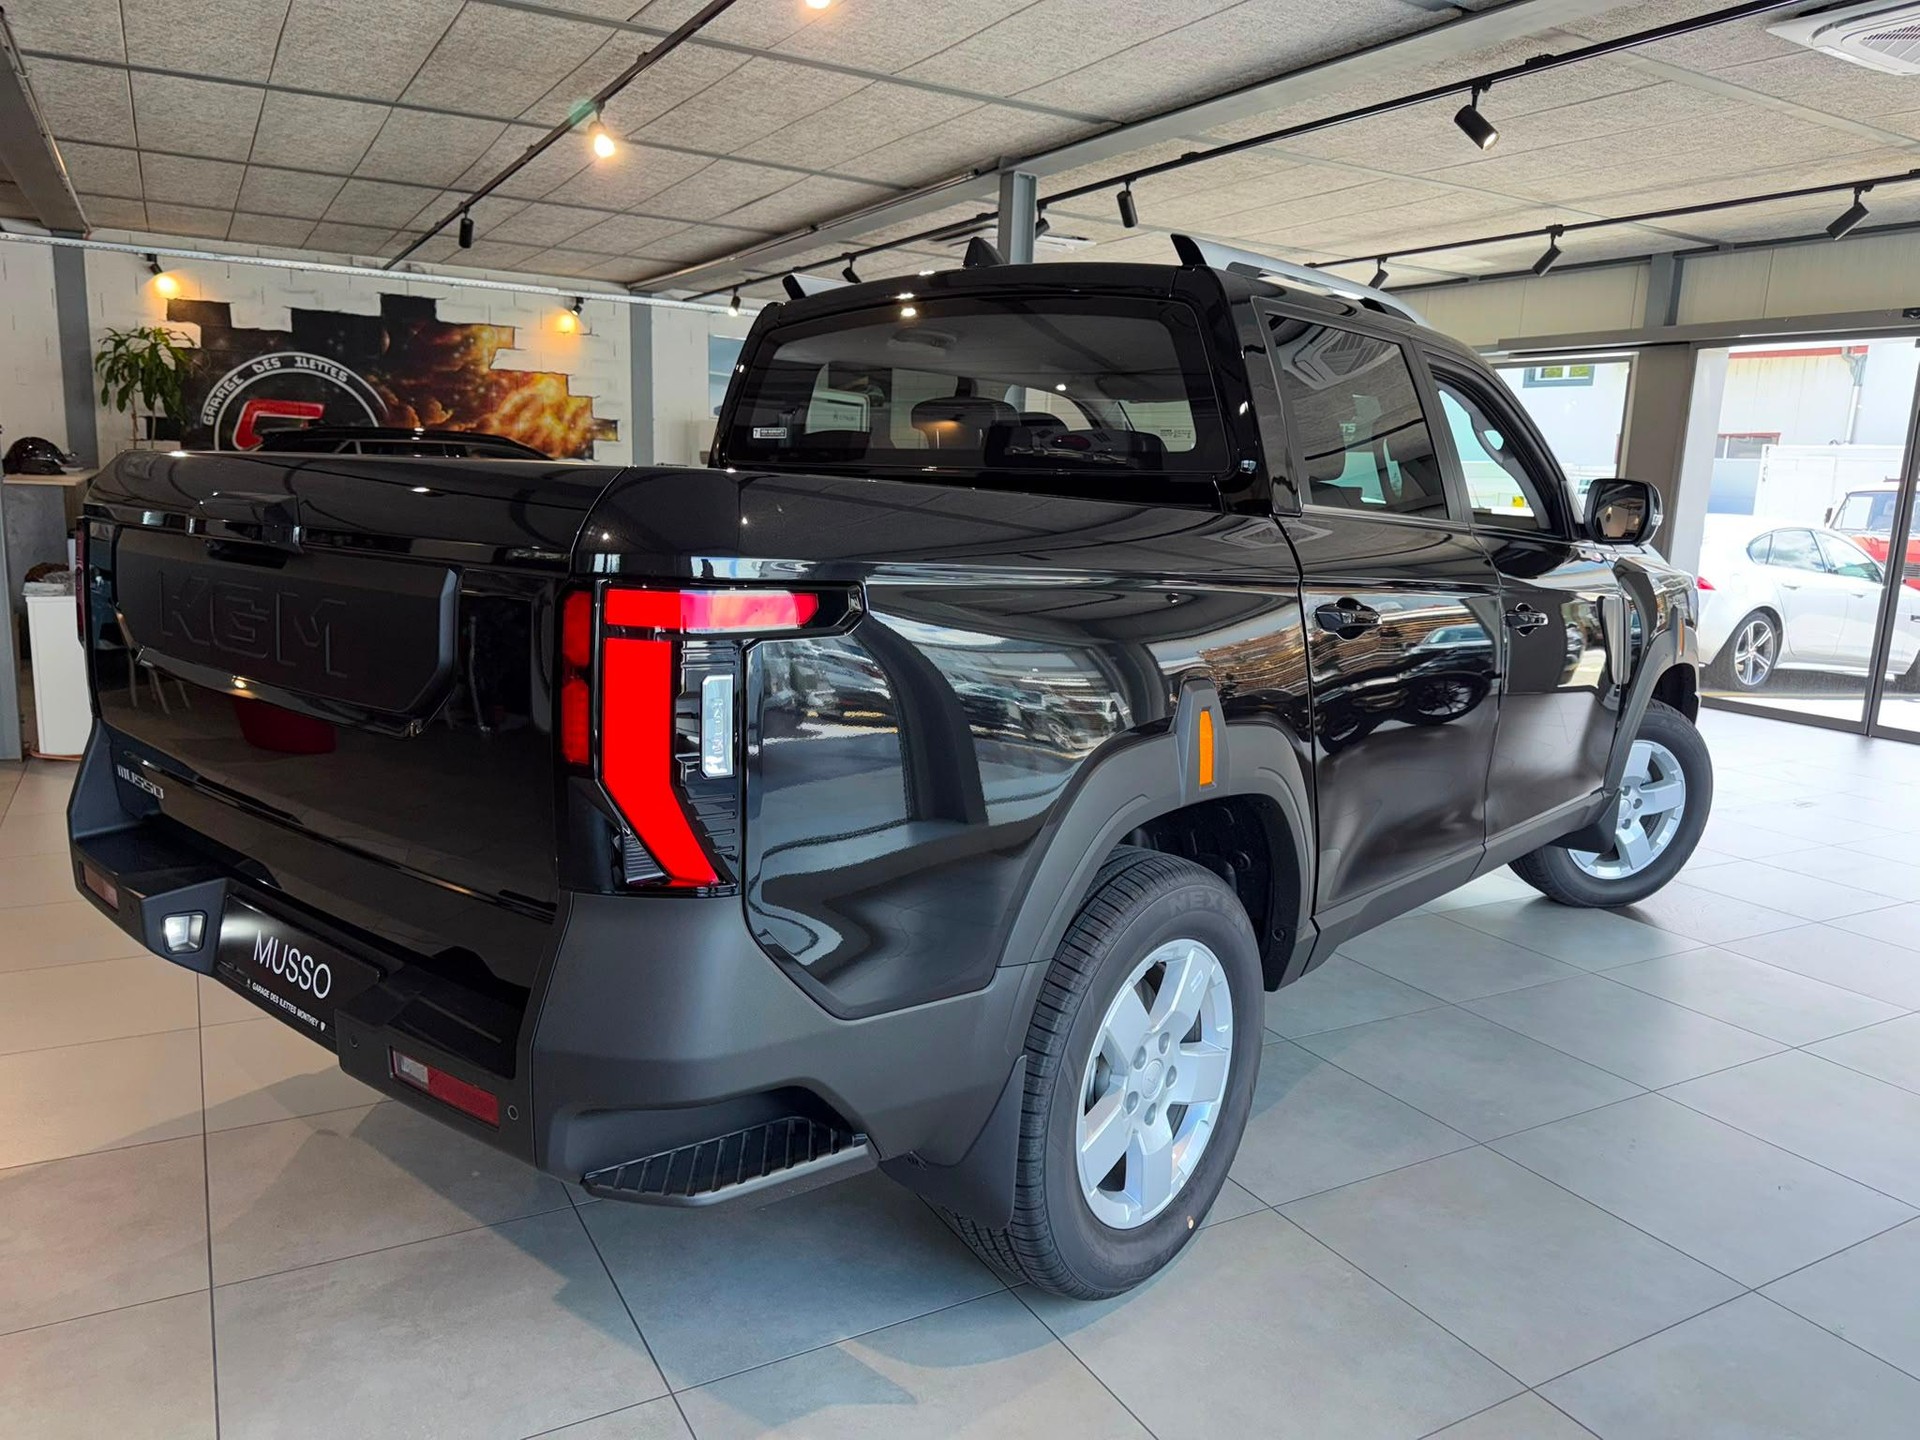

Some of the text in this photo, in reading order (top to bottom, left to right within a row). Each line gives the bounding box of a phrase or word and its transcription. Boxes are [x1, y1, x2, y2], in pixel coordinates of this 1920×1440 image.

[203, 356, 348, 426] GARAGE DES ILETTES
[159, 569, 348, 678] KGM
[117, 764, 164, 799] MUSSO
[252, 982, 270, 998] GARAGE
[270, 993, 279, 1004] DES
[253, 930, 331, 999] MUSSO
